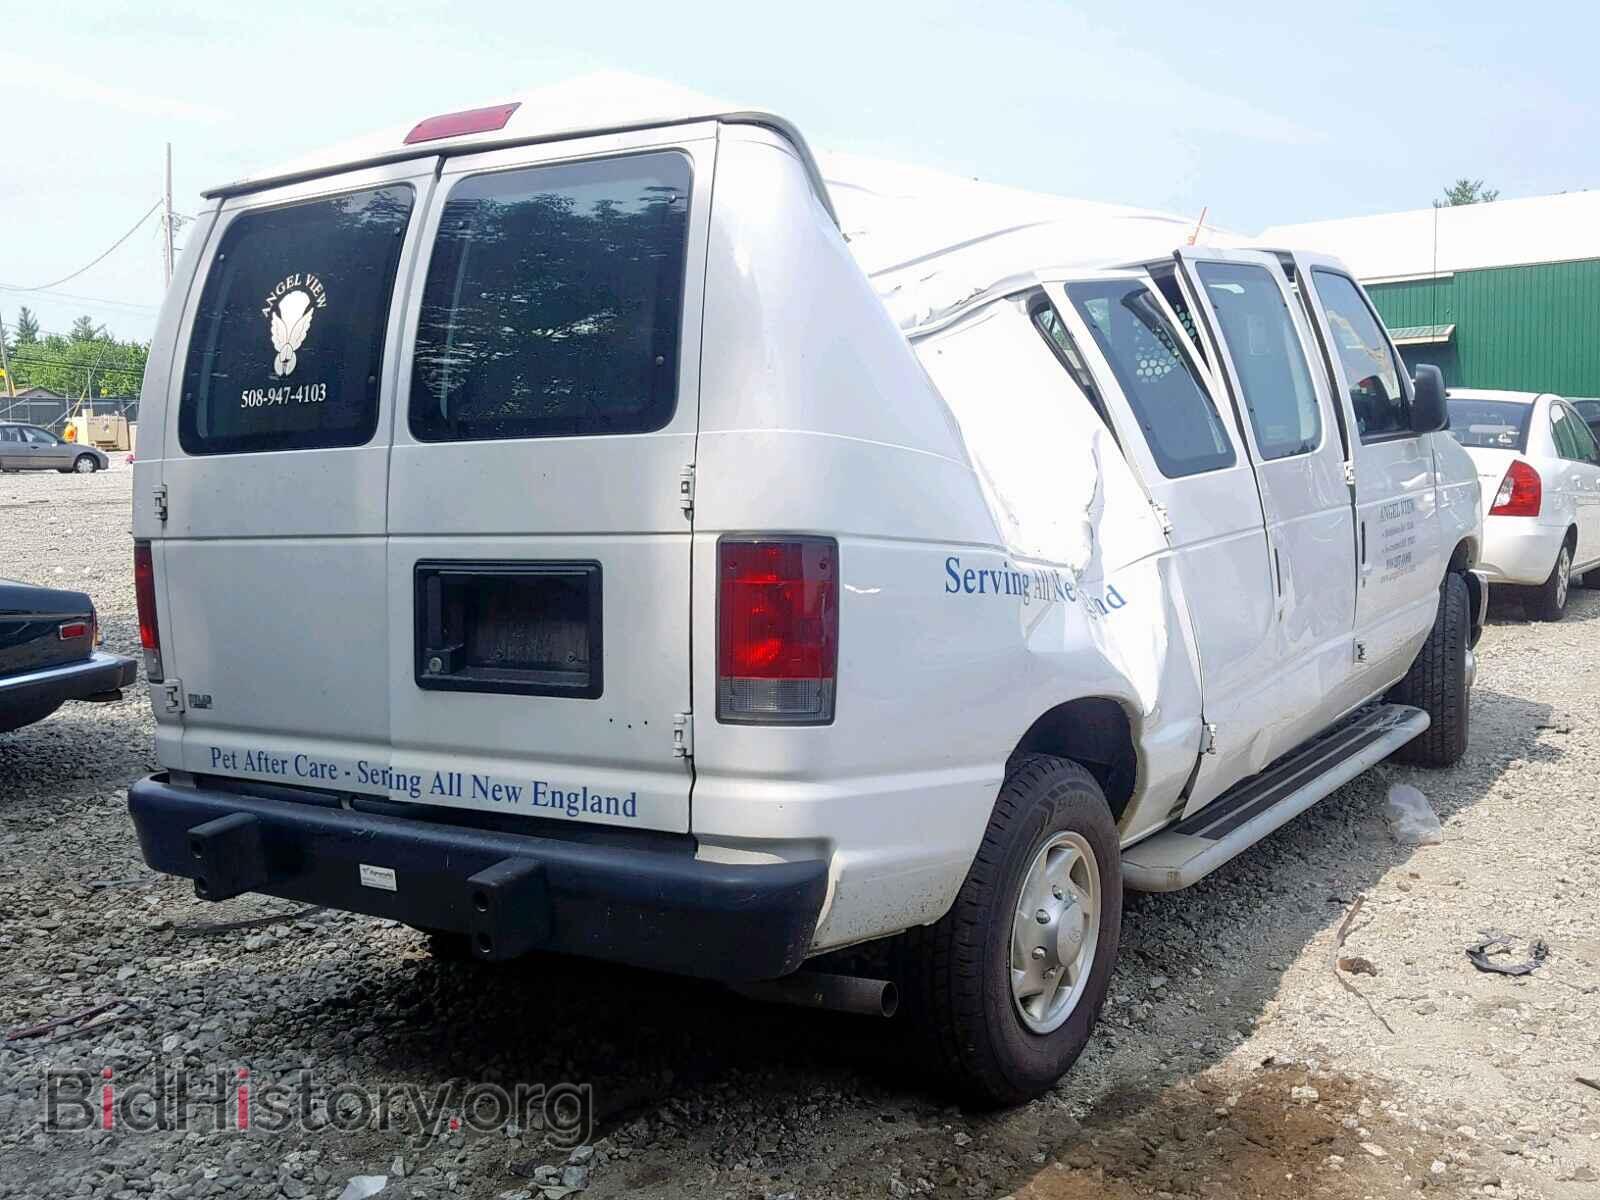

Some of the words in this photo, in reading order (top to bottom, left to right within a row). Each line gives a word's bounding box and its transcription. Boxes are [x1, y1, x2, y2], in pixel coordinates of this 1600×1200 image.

[262, 273, 302, 317] ANGEL
[304, 274, 327, 308] VIEW
[241, 383, 327, 408] 508-947-4103
[945, 556, 1030, 606] Serving
[1033, 568, 1050, 601] All
[211, 747, 238, 770] Pet
[244, 750, 288, 775] After
[294, 754, 338, 780] Care
[357, 760, 421, 799] Sering
[429, 770, 462, 797] All
[471, 774, 523, 804] New
[531, 780, 638, 818] England
